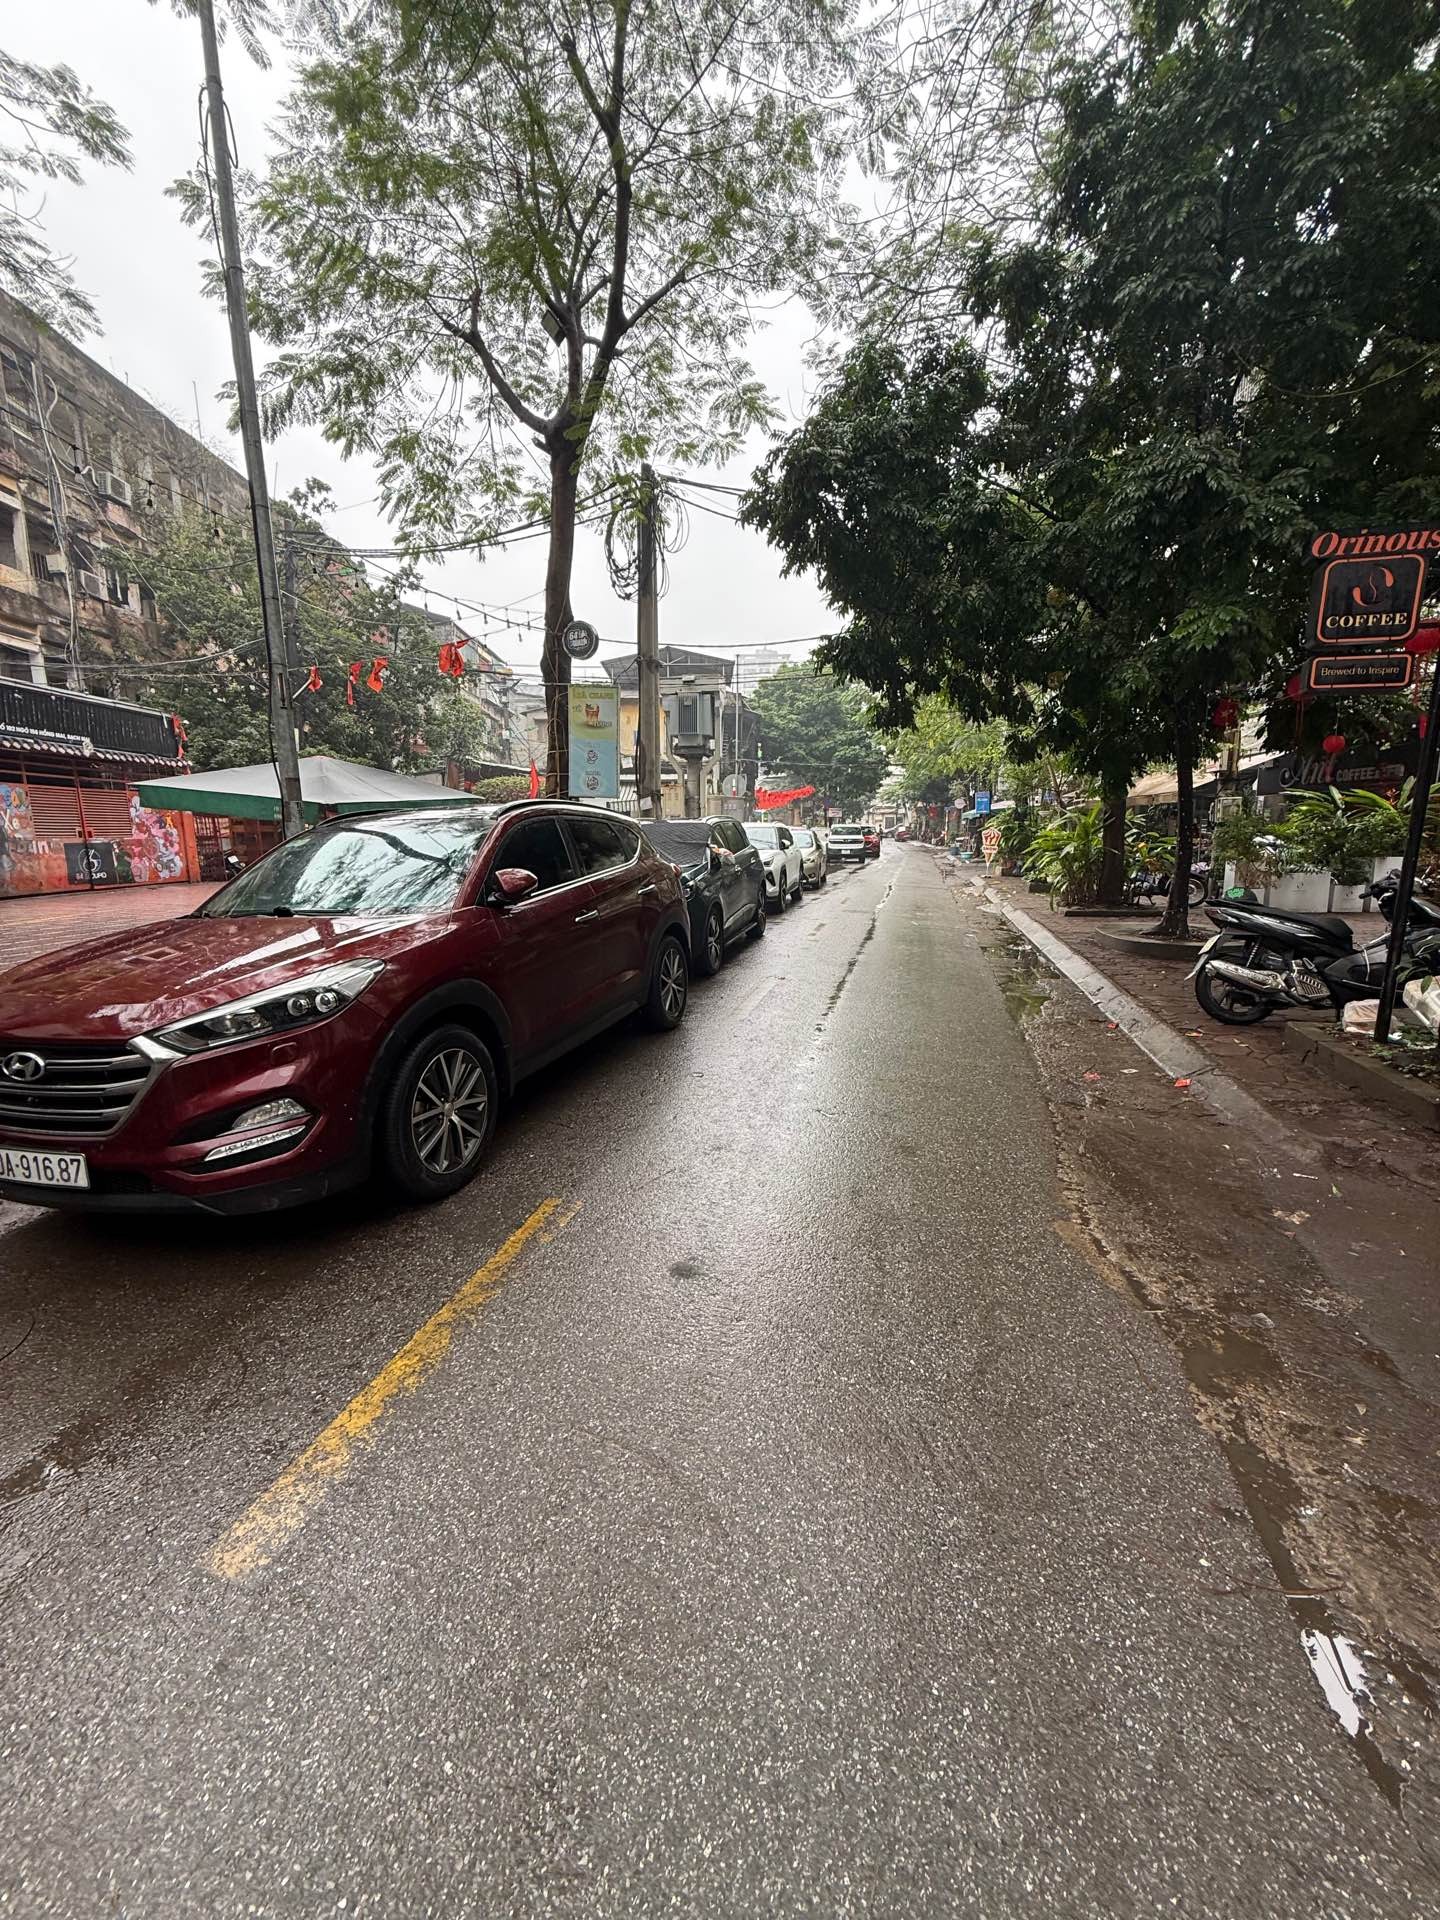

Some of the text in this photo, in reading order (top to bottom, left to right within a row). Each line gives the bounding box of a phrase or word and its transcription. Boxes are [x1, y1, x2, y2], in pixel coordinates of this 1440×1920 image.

[1312, 529, 1440, 558] Orinous
[1326, 612, 1408, 629] COFFEE
[1321, 666, 1400, 677] Brewed to Inspire
